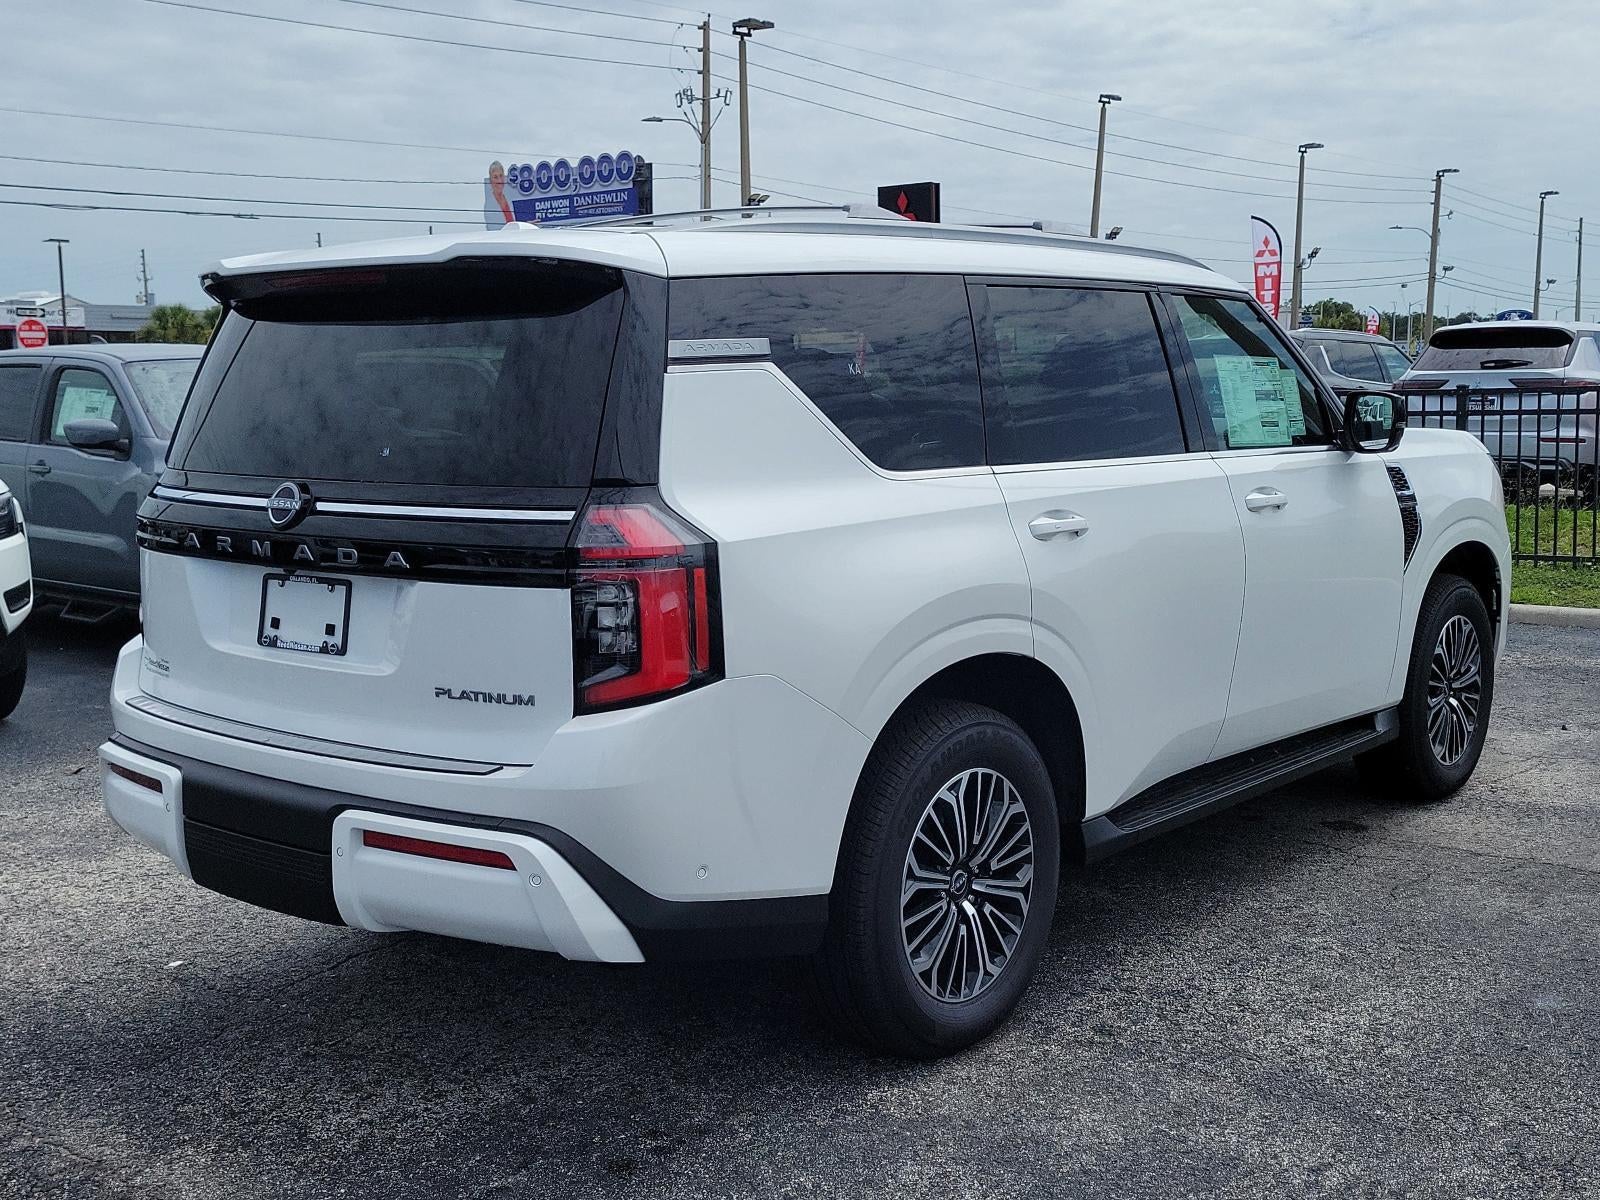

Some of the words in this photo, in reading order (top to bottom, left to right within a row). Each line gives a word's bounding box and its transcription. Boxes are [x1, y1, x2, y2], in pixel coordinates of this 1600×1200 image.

[508, 150, 636, 194] $800,000
[535, 200, 552, 210] DAN
[552, 198, 570, 208] WON
[573, 196, 593, 207] DAN
[592, 191, 629, 204] NEWLIN
[1257, 264, 1279, 319] MITS
[683, 341, 755, 353] ARMADA
[267, 499, 300, 510] NISSAN
[182, 532, 410, 569] ARMADA
[434, 686, 536, 707] PLATINUM
